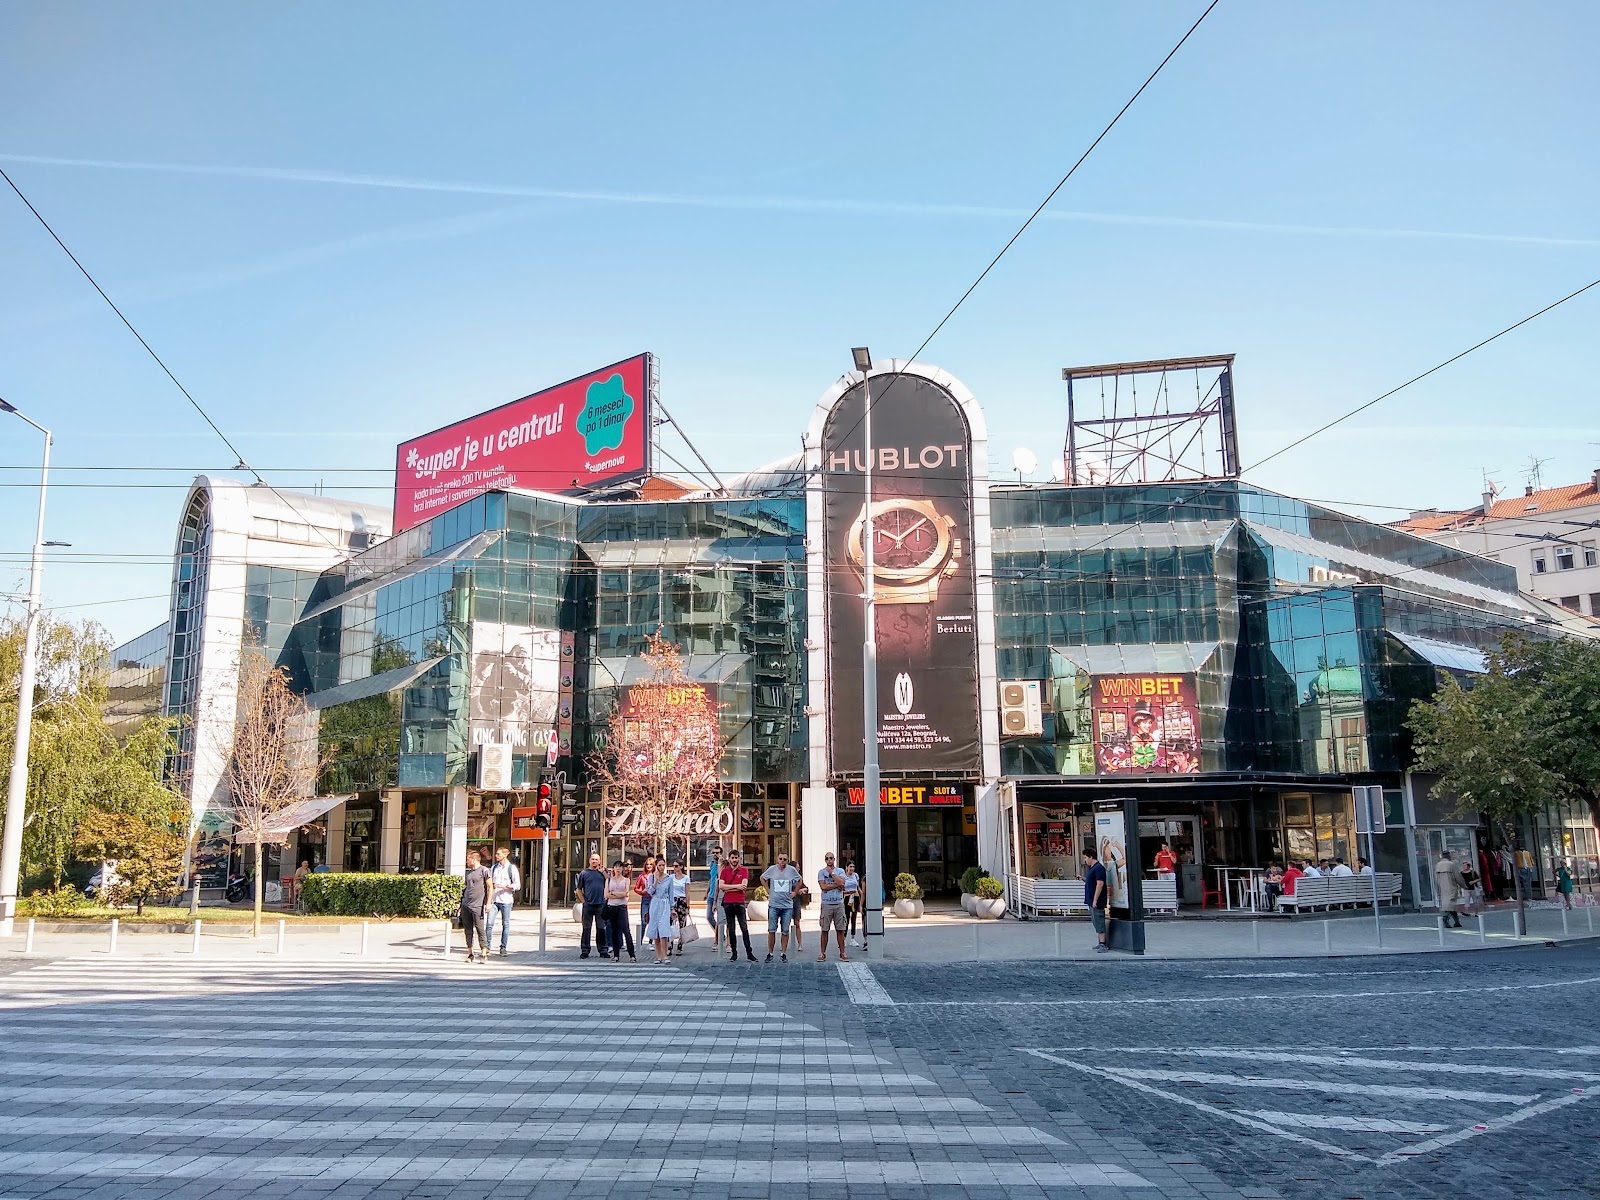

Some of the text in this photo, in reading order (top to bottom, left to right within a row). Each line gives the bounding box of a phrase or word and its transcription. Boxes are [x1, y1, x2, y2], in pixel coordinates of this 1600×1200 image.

[588, 395, 625, 419] 6 meseci
[586, 412, 626, 436] po 1 dinar
[461, 436, 479, 470] je
[483, 434, 494, 456] u
[498, 403, 564, 451] centru!
[829, 445, 962, 472] HUBLOT
[444, 479, 460, 495] preko
[462, 473, 473, 486] 200
[474, 471, 481, 482] TV
[425, 496, 448, 510] internet
[937, 623, 972, 634] Berluti
[1100, 678, 1183, 697] WINBET
[473, 727, 549, 747] KING KONG CAS
[848, 787, 926, 804] WNBET
[934, 787, 950, 795] SLOT
